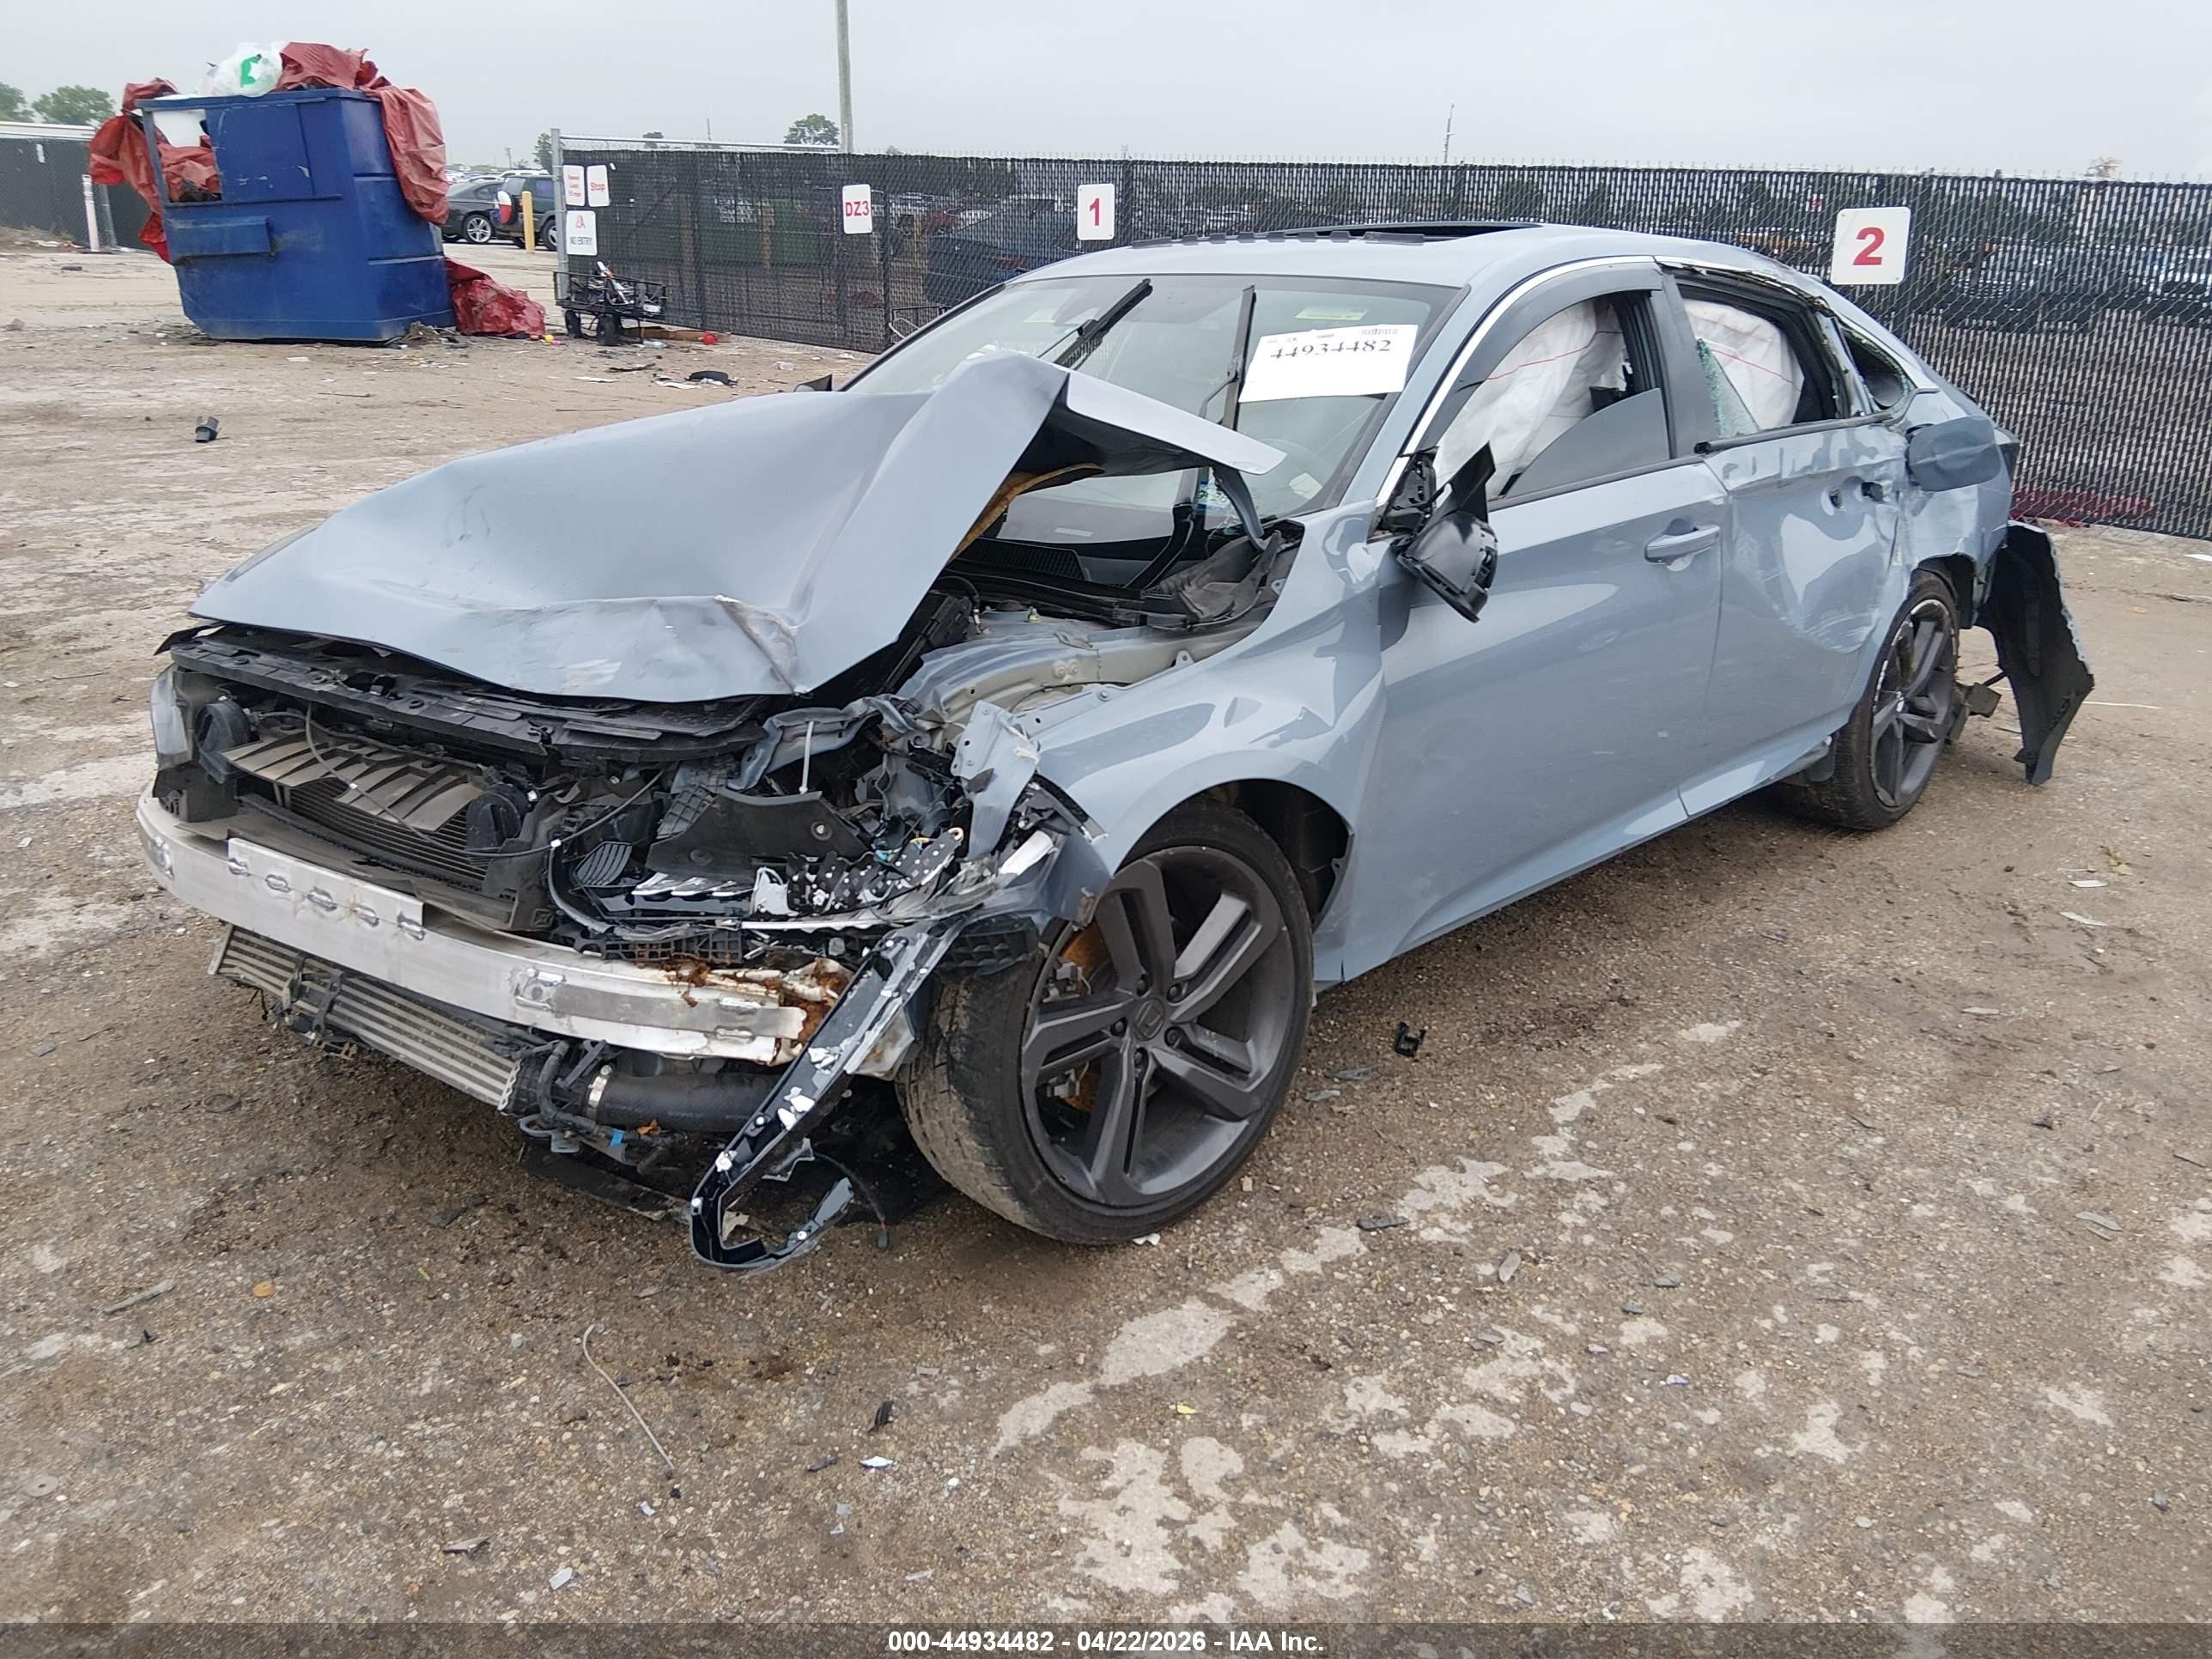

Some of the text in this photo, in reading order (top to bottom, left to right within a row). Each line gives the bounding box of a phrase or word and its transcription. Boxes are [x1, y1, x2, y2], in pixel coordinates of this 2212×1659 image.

[845, 200, 870, 216] DZ3
[1089, 198, 1100, 226] 1
[1852, 227, 1885, 265] 2
[1270, 339, 1392, 359] 44934482
